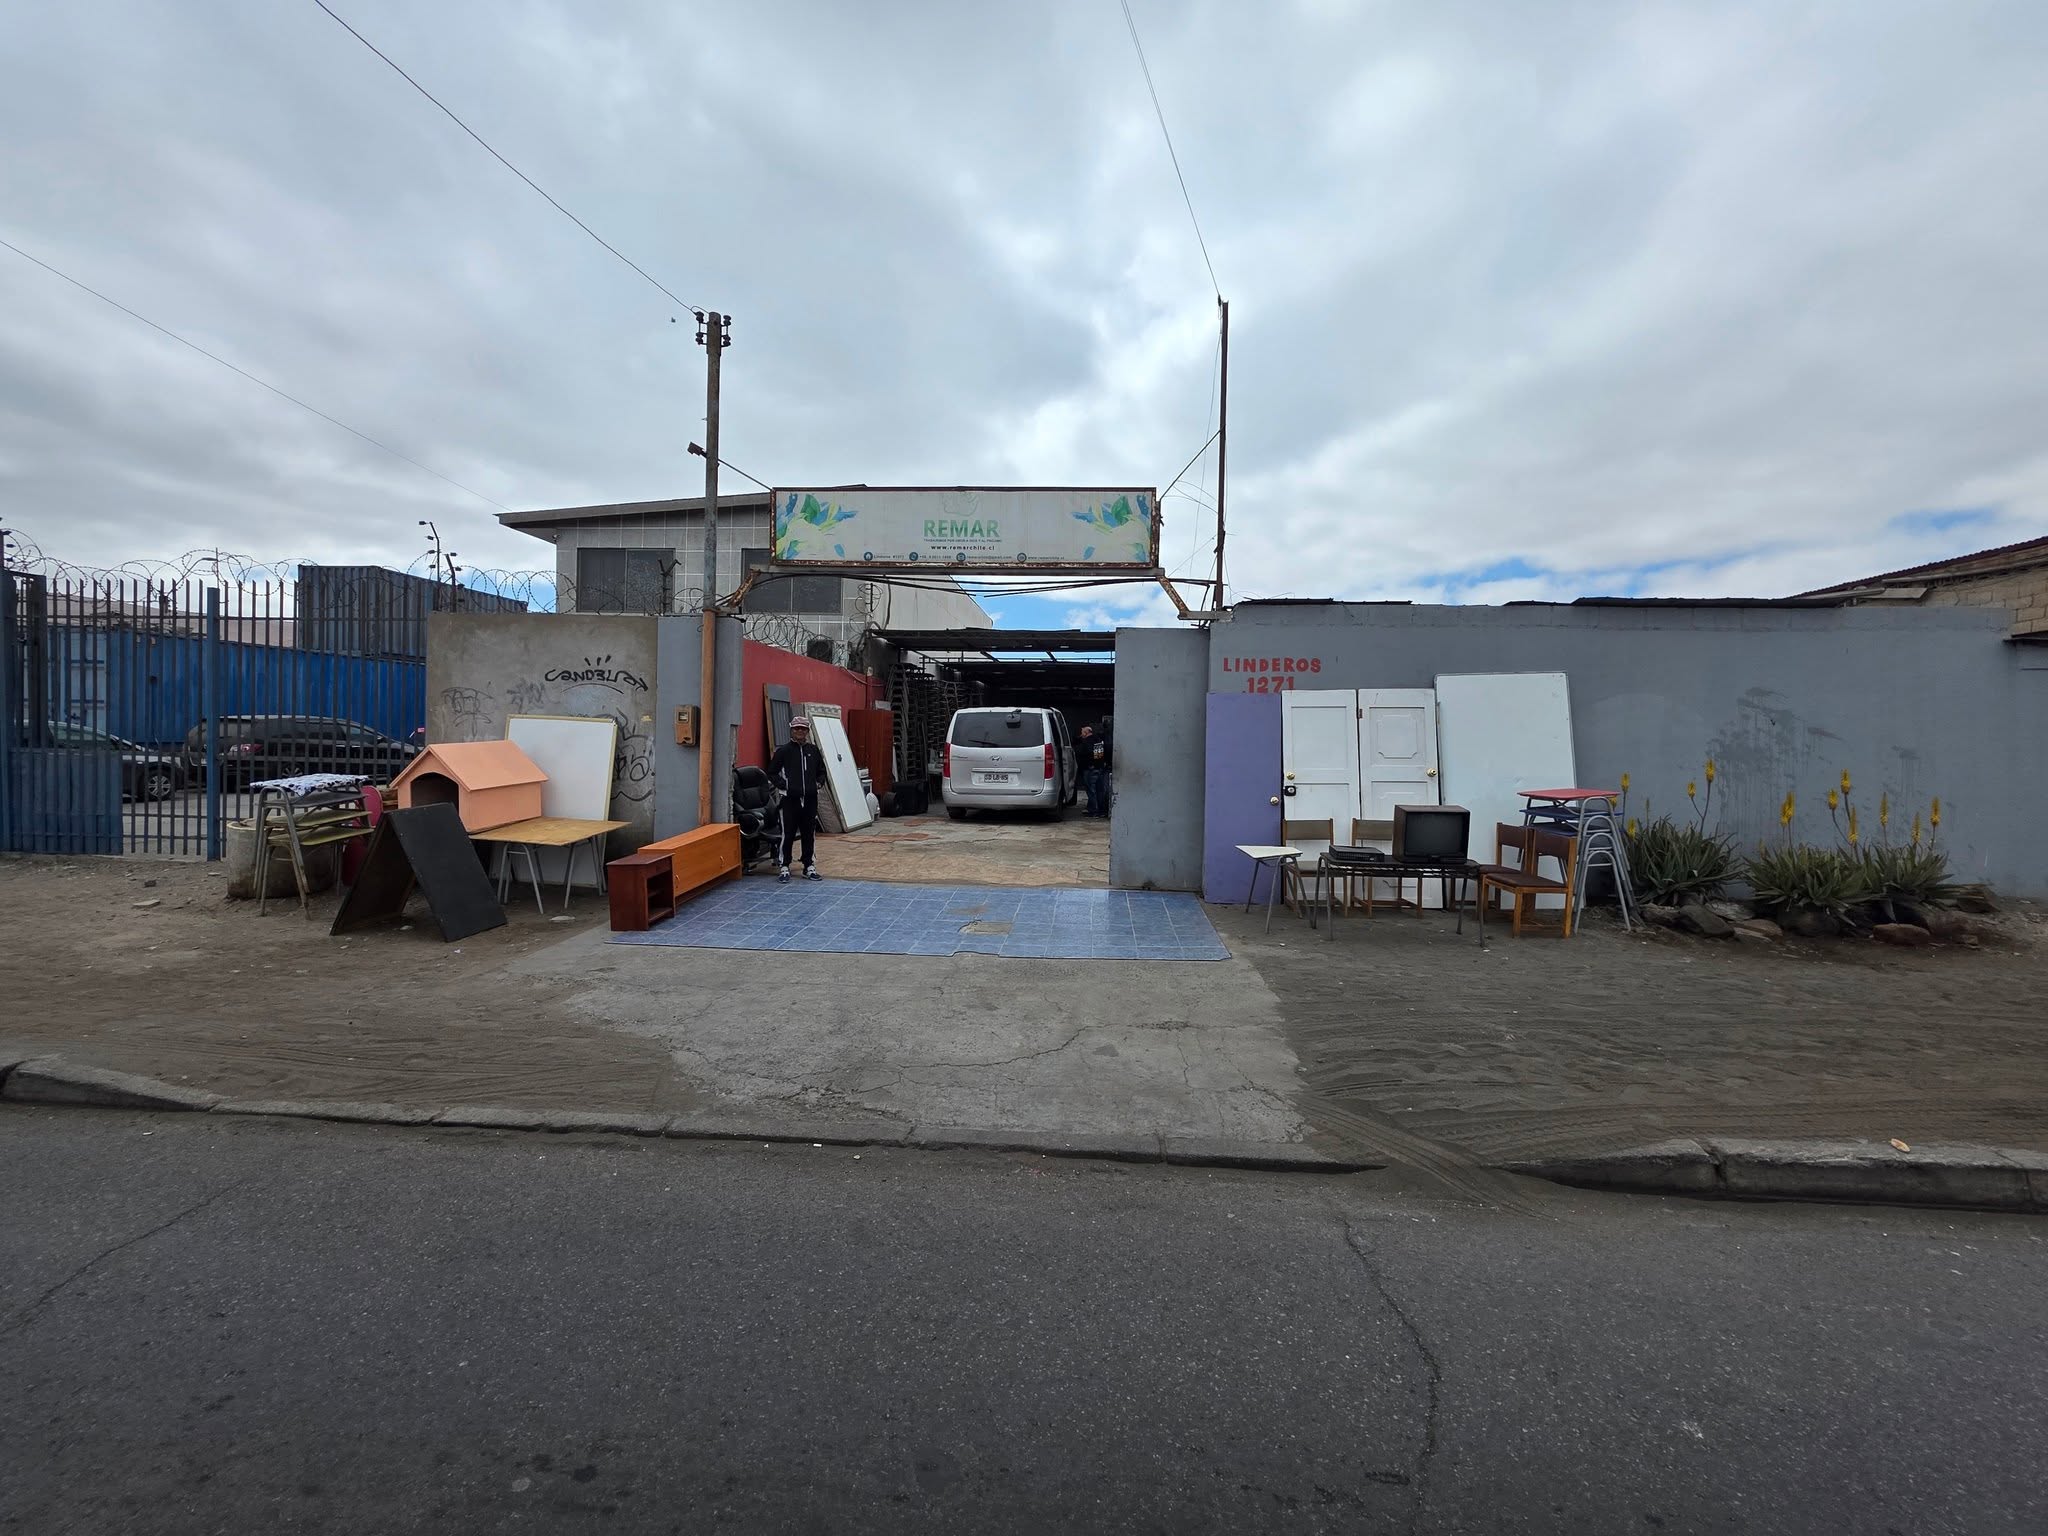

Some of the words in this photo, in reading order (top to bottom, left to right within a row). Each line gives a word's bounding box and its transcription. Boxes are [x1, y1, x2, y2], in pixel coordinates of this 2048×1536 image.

[923, 519, 1000, 537] REMAR
[1223, 657, 1322, 673] LINDEROS
[1247, 676, 1296, 694] 1271
